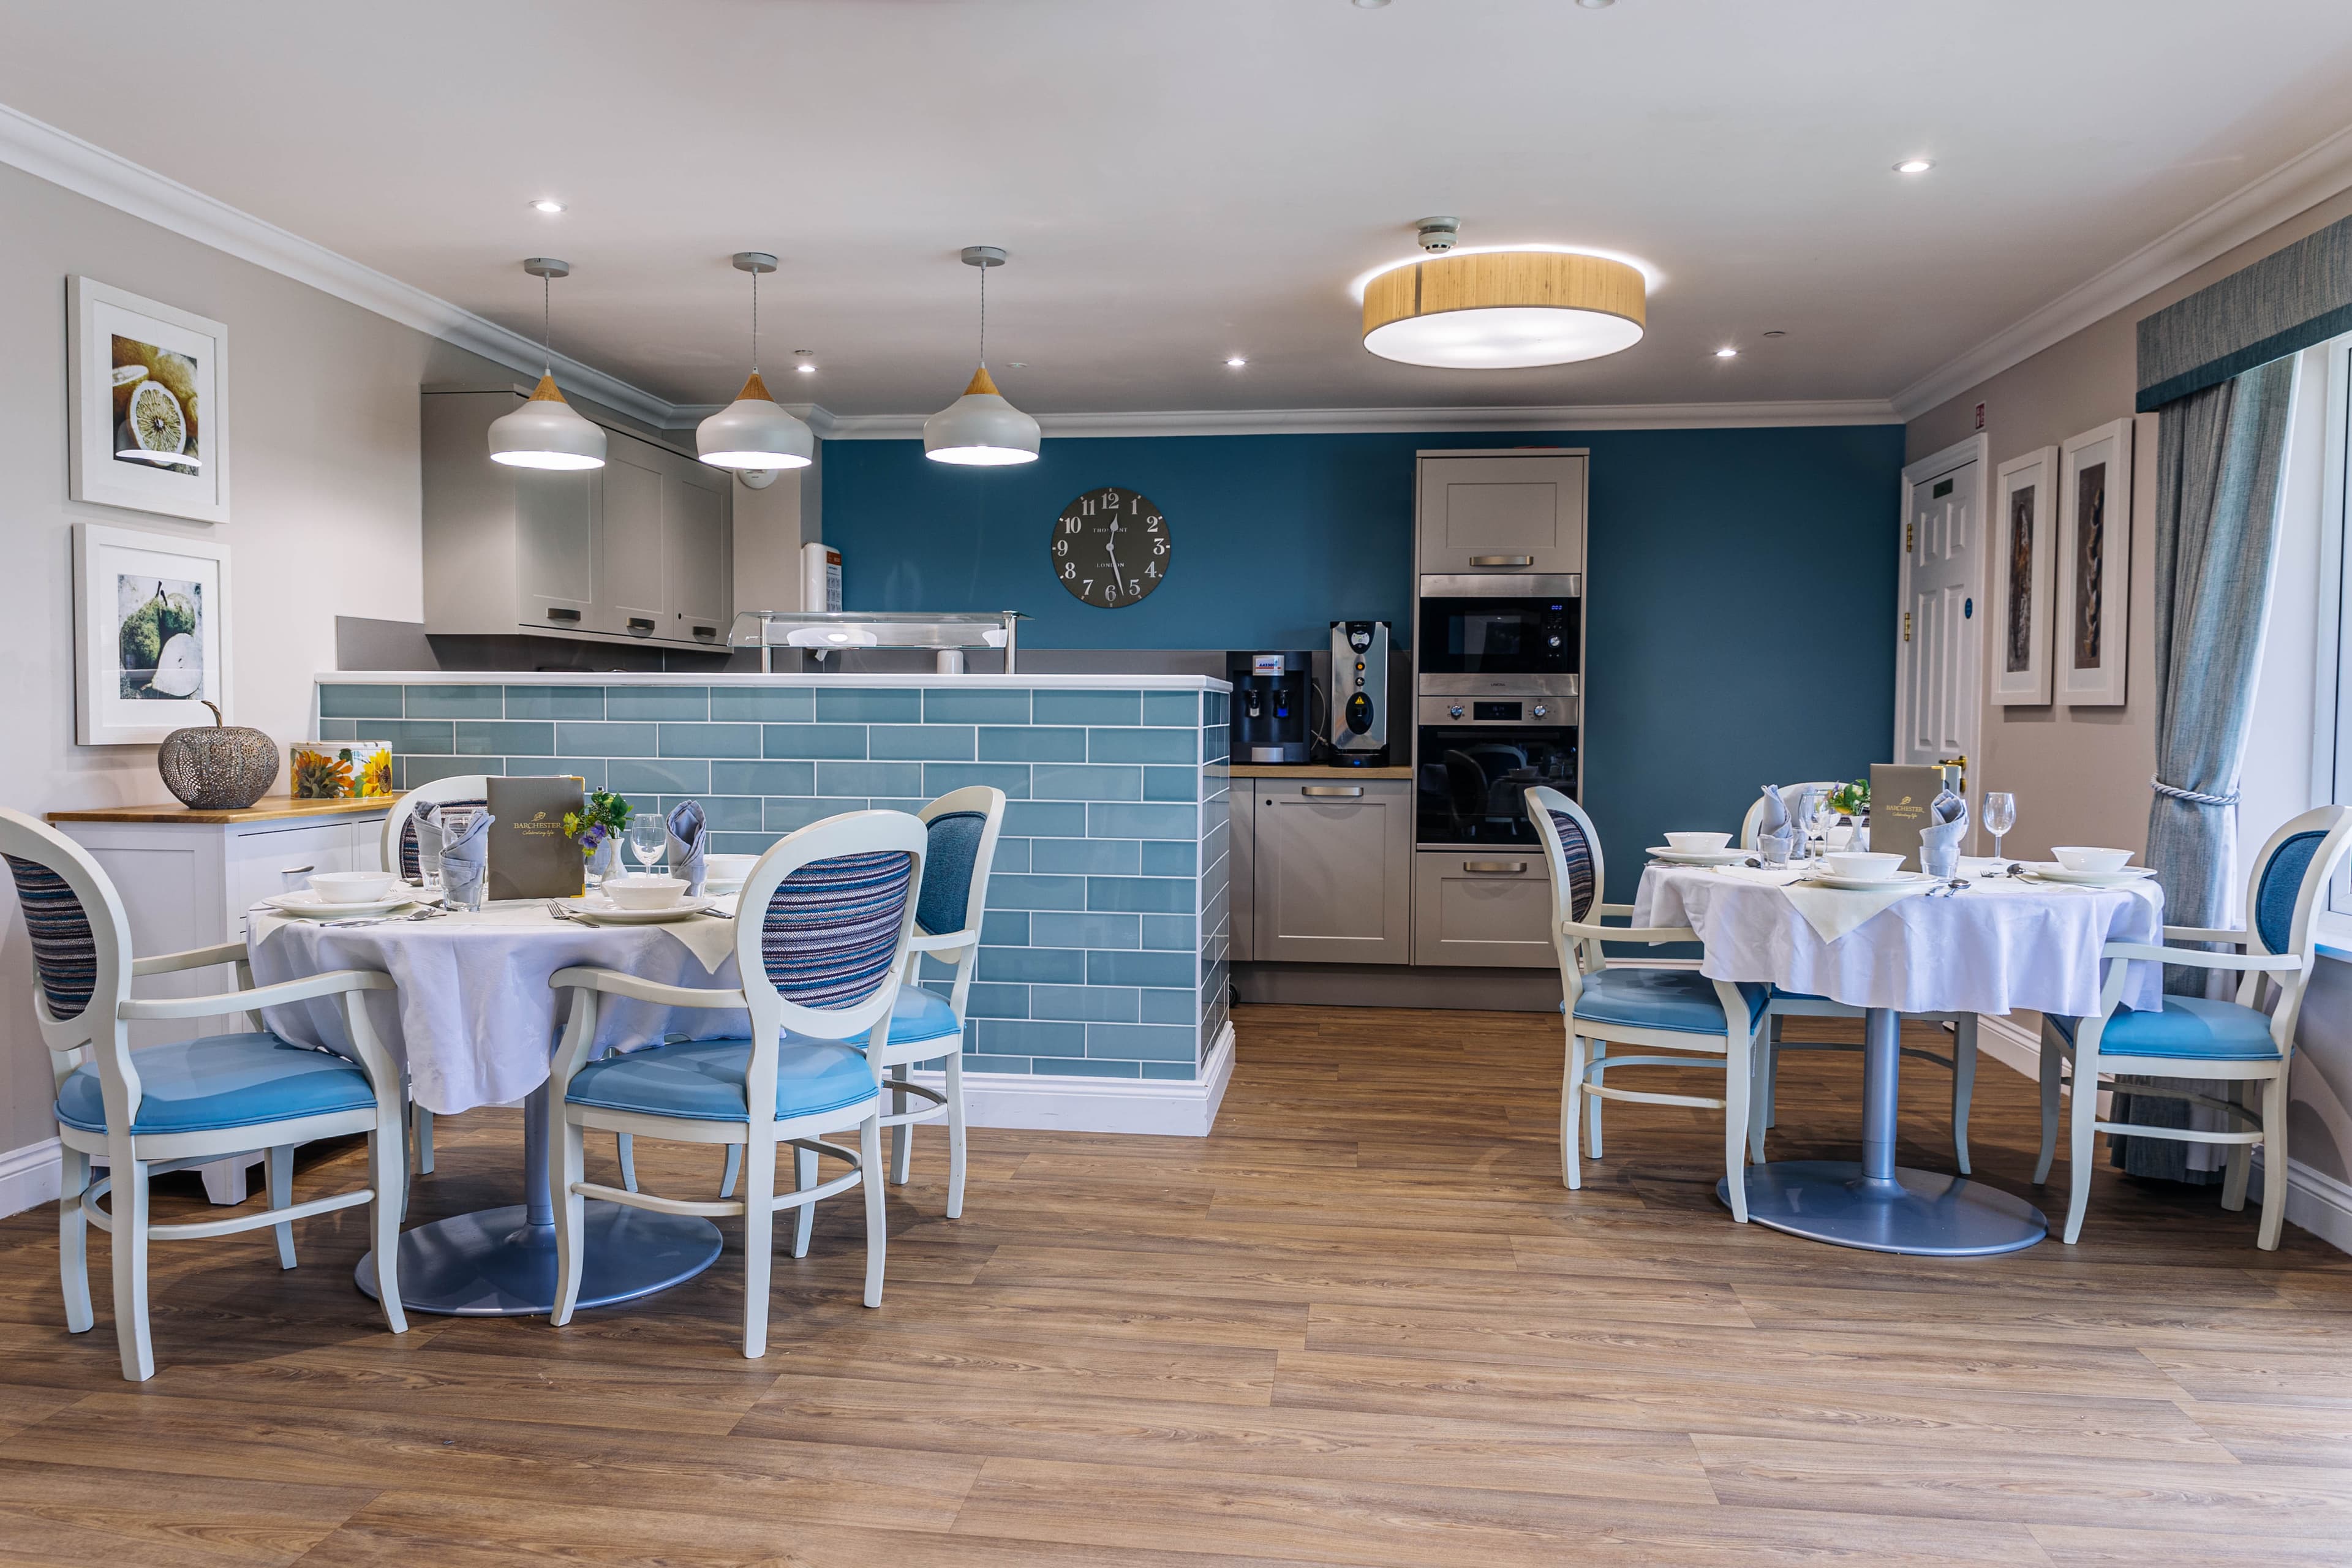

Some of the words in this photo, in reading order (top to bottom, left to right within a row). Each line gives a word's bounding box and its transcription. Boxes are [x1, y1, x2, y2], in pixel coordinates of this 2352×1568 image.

[1082, 499, 1095, 515] 11
[1101, 493, 1119, 509] 12
[1131, 499, 1138, 514] 1
[1065, 516, 1082, 533] 10
[1147, 516, 1158, 532] 2
[1057, 540, 1068, 556] 9
[1153, 538, 1165, 555] 3
[1065, 562, 1076, 579] 8
[1144, 561, 1157, 578] 4
[1083, 579, 1094, 595] 7
[1105, 585, 1116, 601] 6
[1129, 579, 1140, 595] 5
[1886, 805, 1924, 813] BARCHESTER
